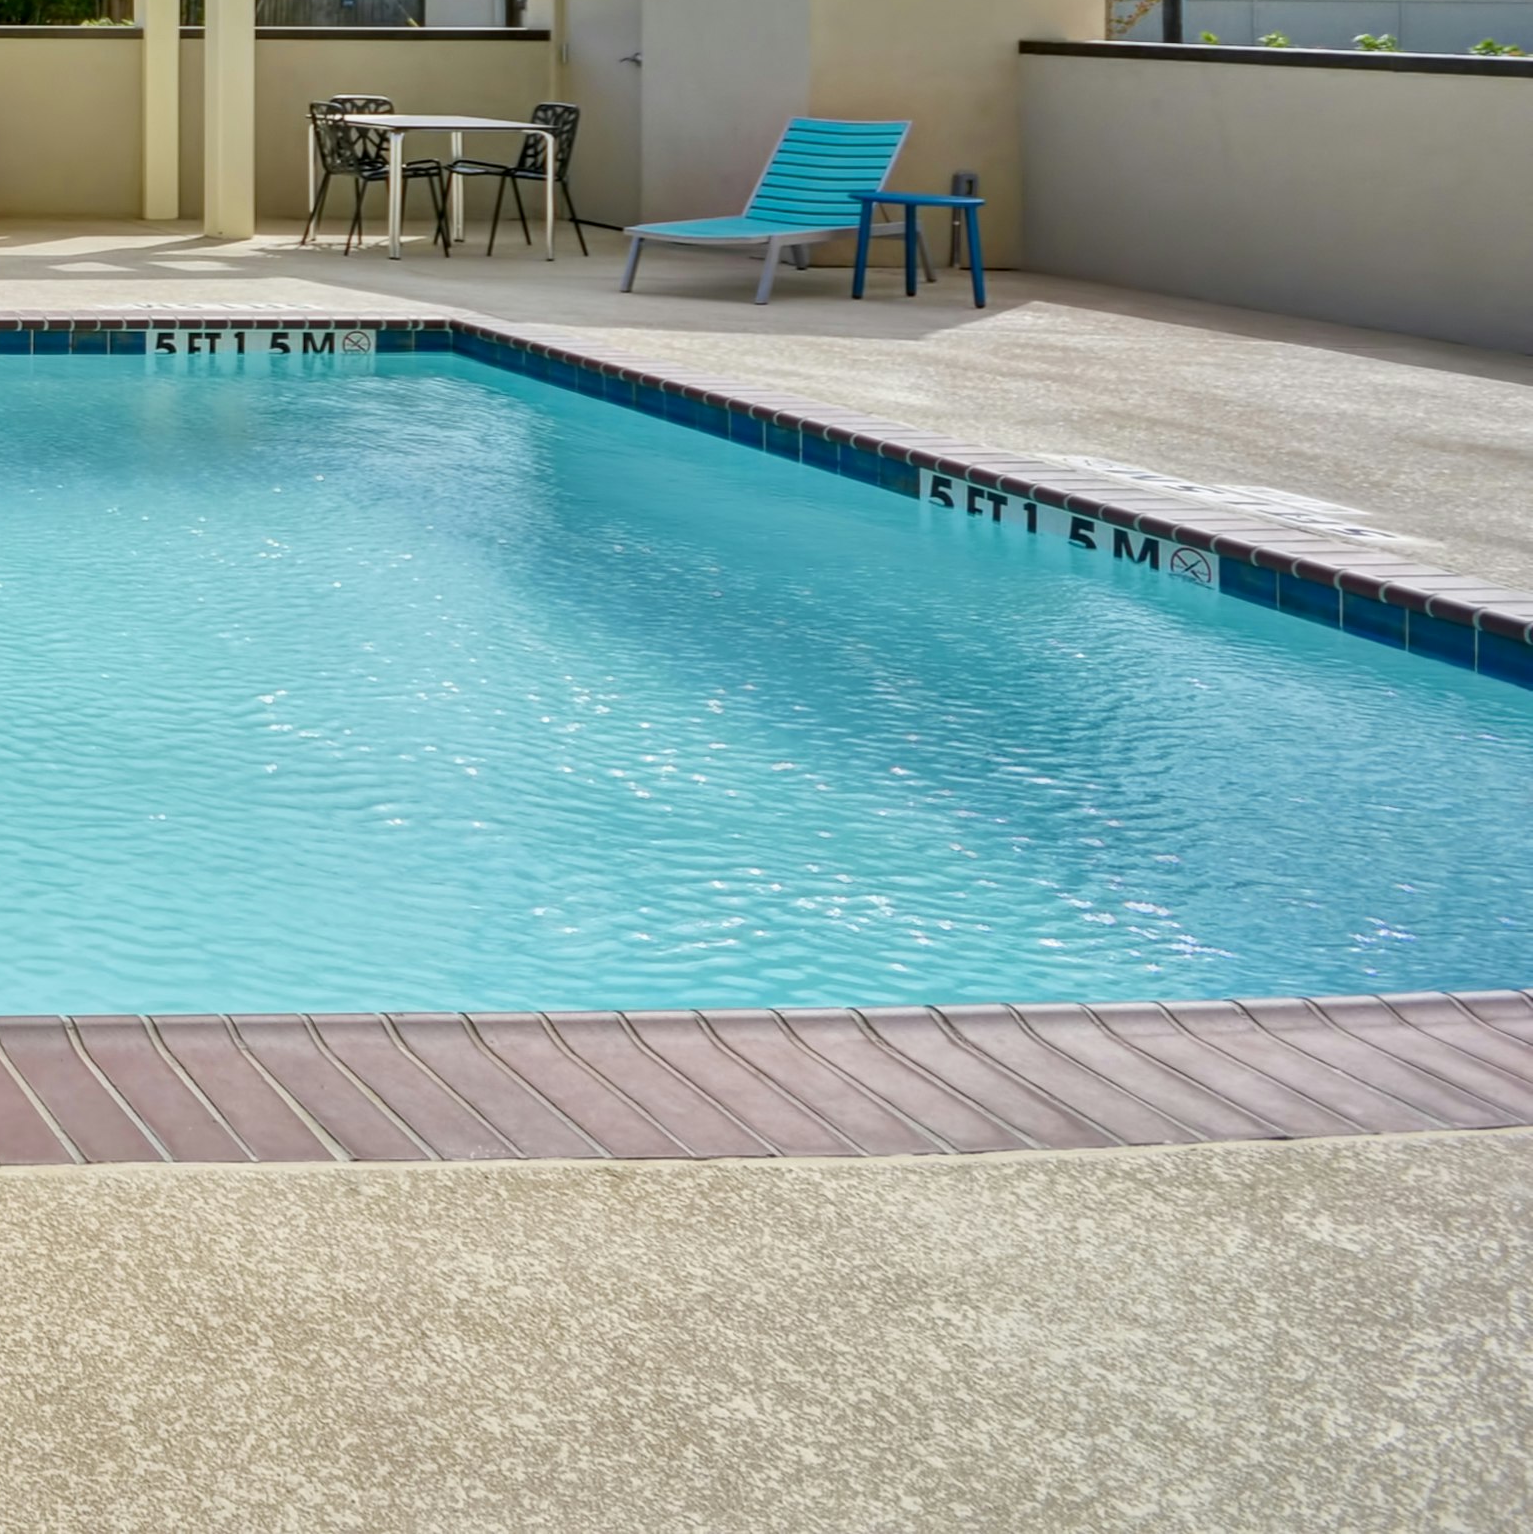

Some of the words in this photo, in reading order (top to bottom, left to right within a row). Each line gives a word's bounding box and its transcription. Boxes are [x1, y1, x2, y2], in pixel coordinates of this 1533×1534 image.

[302, 332, 335, 354] M
[929, 474, 954, 508] 5
[1113, 528, 1160, 570] M
